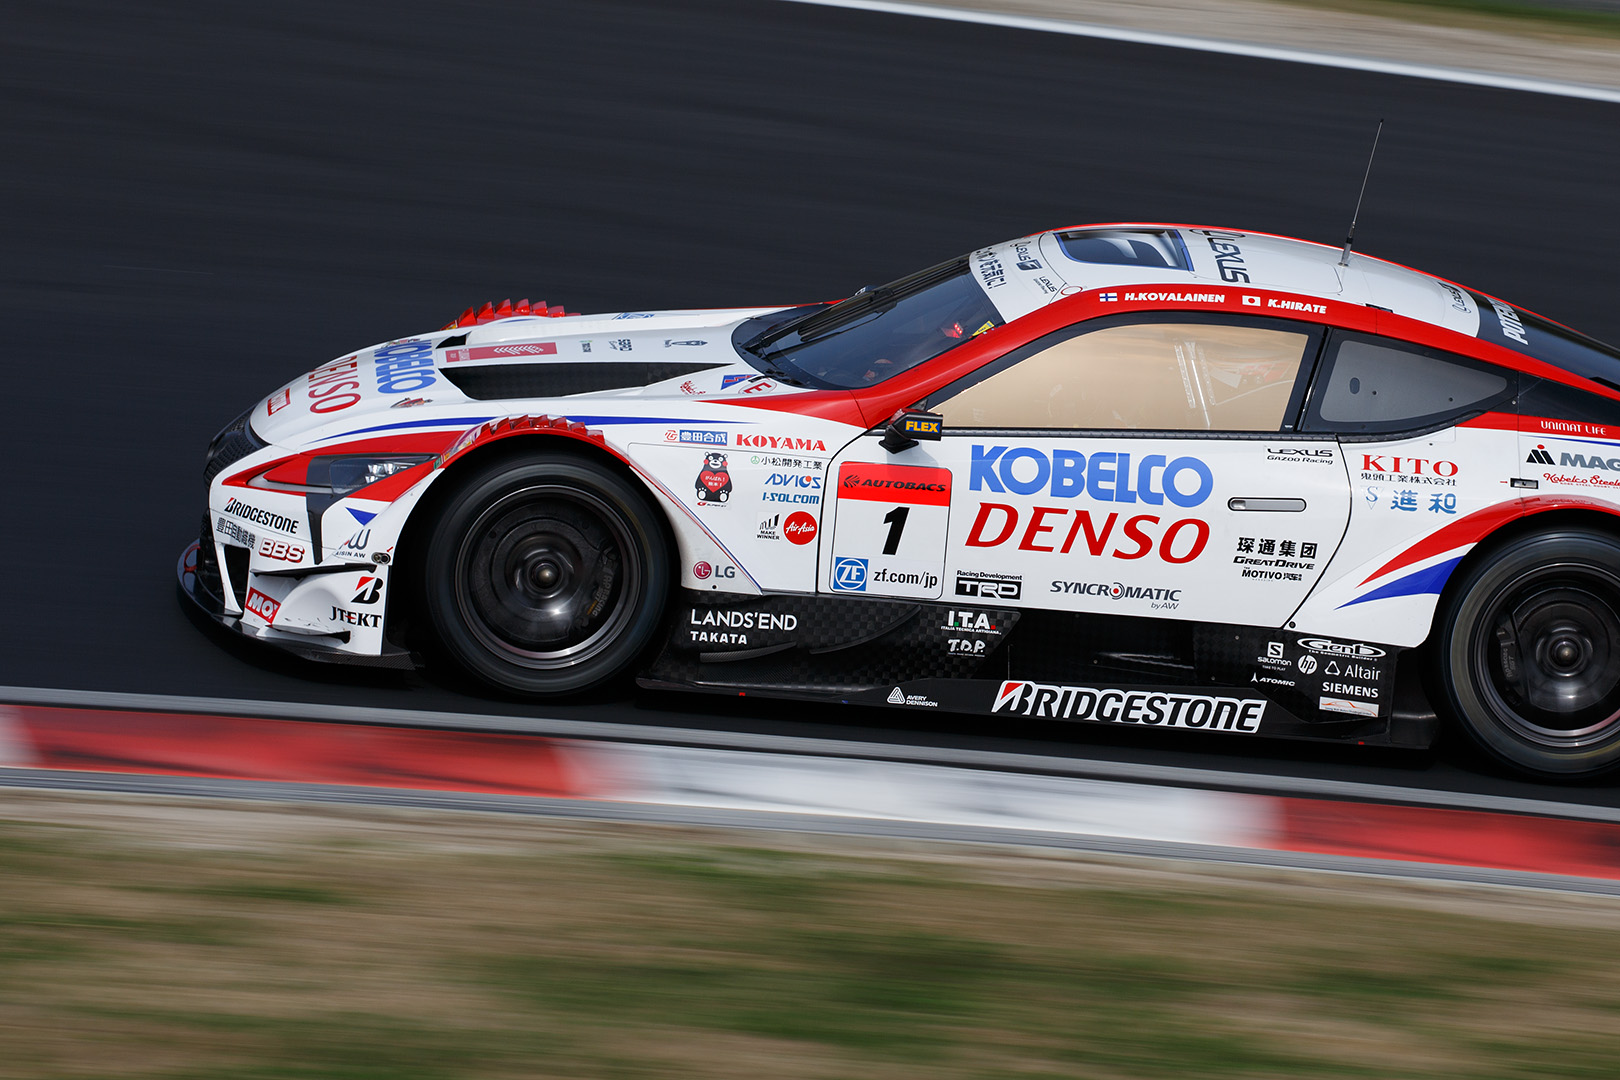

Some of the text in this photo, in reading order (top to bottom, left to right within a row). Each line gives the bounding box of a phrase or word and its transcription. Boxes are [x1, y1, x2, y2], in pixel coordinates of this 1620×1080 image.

[1208, 237, 1250, 284] LEXUS
[1124, 292, 1225, 304] H.KOVALAINEN
[1267, 299, 1327, 314] K.HIRATE
[905, 420, 939, 434] FLEX
[1541, 420, 1607, 436] UNIMAT LIFE
[736, 434, 826, 452] KOYAMA
[1267, 448, 1334, 458] LEXUS
[1267, 455, 1334, 465] GAZOO Racing
[761, 456, 823, 471] 小松開発工業
[1361, 453, 1459, 477] KITO
[764, 473, 822, 489] ADVICS
[968, 444, 1214, 508] KOBELCO
[1543, 472, 1588, 485] Kobelco
[861, 479, 946, 492] AUTOBACS
[762, 492, 820, 505] I-SOLCOM
[1390, 489, 1457, 515] 進和
[224, 497, 300, 535] BRIDGESTONE
[882, 506, 910, 556] 1
[964, 502, 1210, 564] DENSO
[259, 538, 306, 564] BBS
[715, 565, 736, 579] LG
[839, 564, 865, 584] ZF
[873, 568, 938, 589] zf.com/jp
[957, 569, 1023, 581] Racing Development
[1242, 569, 1282, 580] MOTIVO
[958, 580, 1018, 599] TRD
[1050, 580, 1182, 602] SYNCROMATIC
[1161, 602, 1180, 610] AW
[328, 606, 382, 628] JTEKT
[690, 608, 798, 632] LANDS'END
[947, 610, 997, 630] I.T.A.
[690, 630, 748, 645] TAKATA
[1298, 655, 1318, 675] hp
[1344, 664, 1381, 681] Altair
[1259, 677, 1296, 687] ATOMIC
[1322, 681, 1379, 698] SIEMENS
[906, 695, 927, 703] AVERY
[906, 700, 938, 708] DENNISON
[991, 680, 1267, 733] BRIDGESTONE
